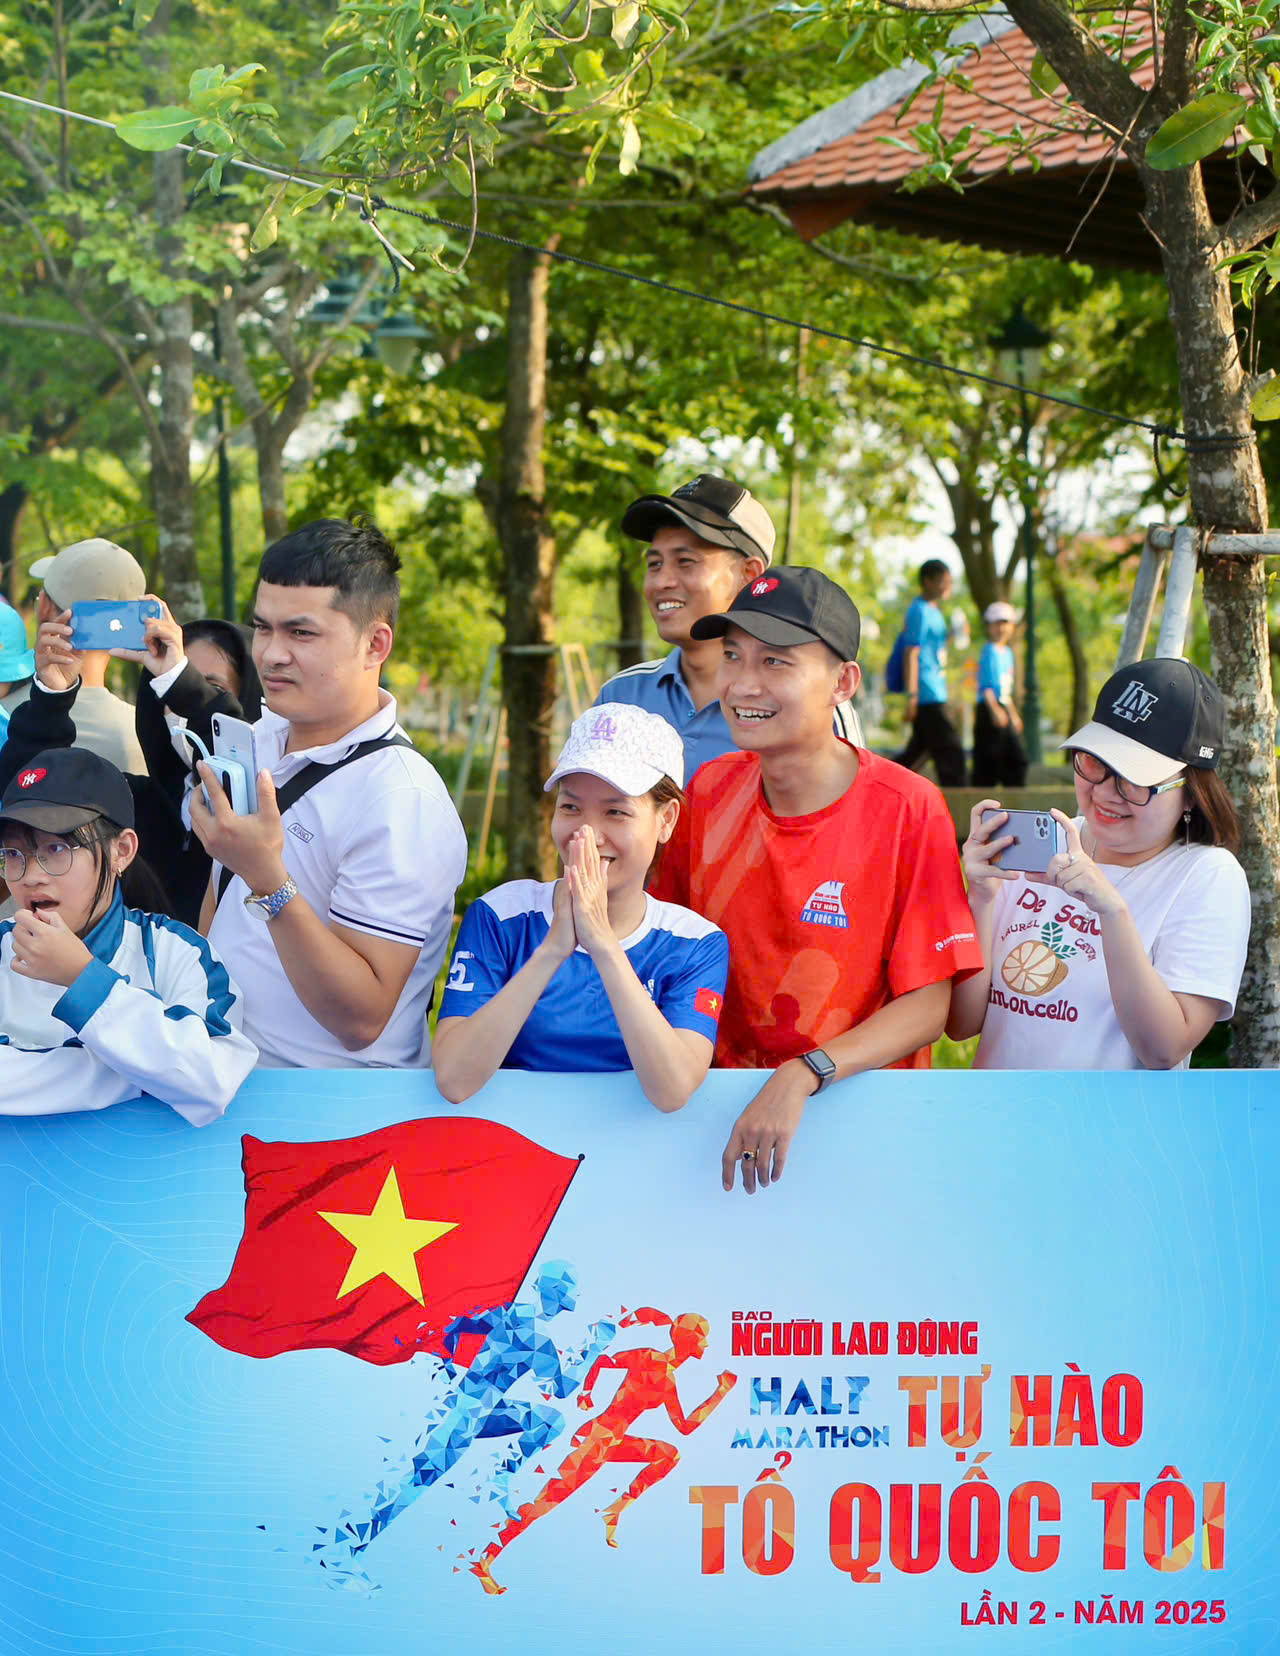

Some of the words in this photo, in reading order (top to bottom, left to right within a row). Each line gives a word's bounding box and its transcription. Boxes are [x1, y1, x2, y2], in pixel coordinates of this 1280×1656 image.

[1017, 888, 1047, 912] De
[988, 983, 1078, 1022] imoncello
[731, 1319, 823, 1356] NGƯỜI
[832, 1322, 889, 1355] LAO
[897, 1318, 978, 1357] ĐỘNG
[750, 1376, 870, 1416] HALF
[898, 1364, 992, 1462] TỰ
[1010, 1362, 1144, 1448] HÀO
[730, 1425, 890, 1449] MARATHON
[688, 1451, 795, 1576] TỔ
[829, 1451, 1061, 1583] QUỐC
[1091, 1465, 1225, 1573] TÔI
[960, 1588, 1018, 1626] LẦN
[1028, 1601, 1046, 1625] 2
[1074, 1594, 1144, 1625] NĂM
[1154, 1599, 1227, 1625] 2025
